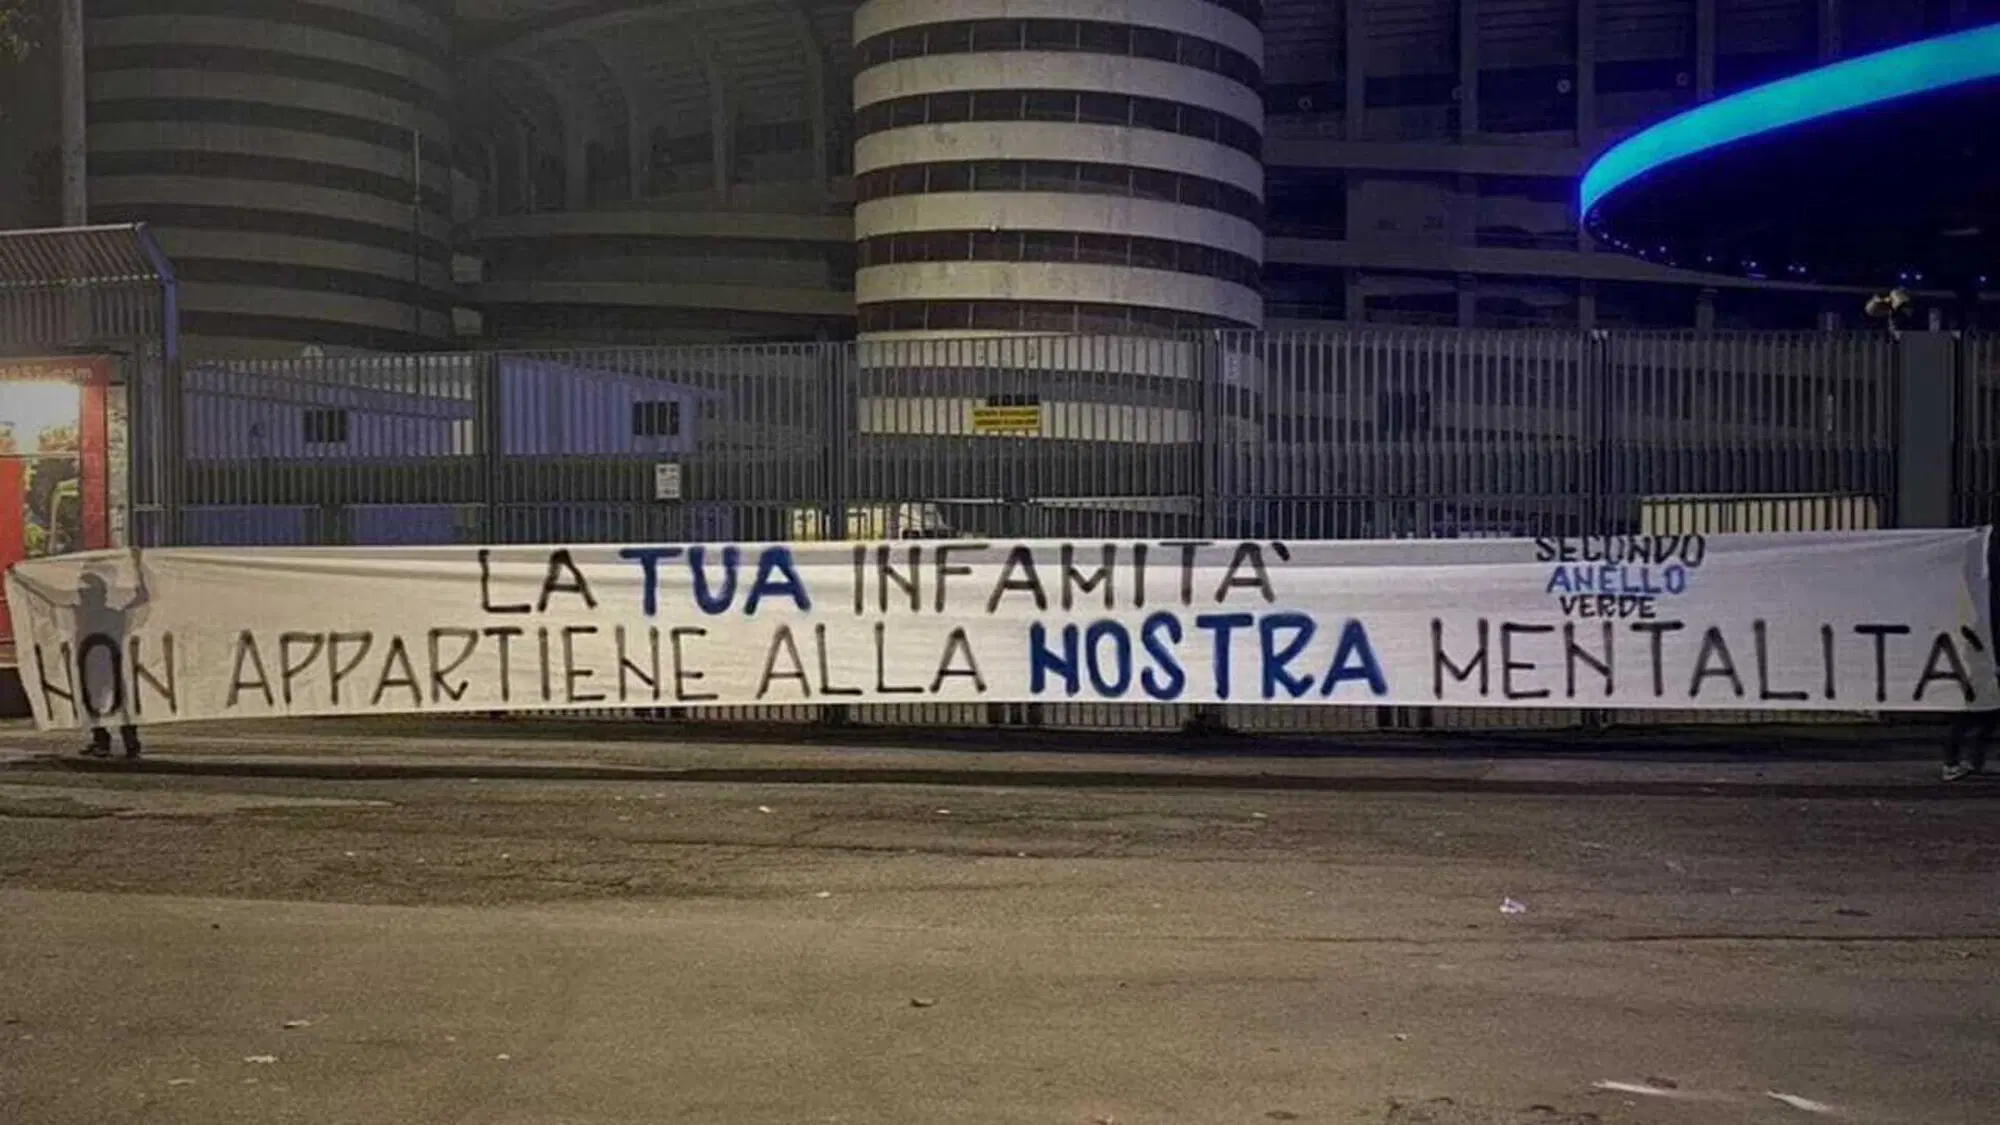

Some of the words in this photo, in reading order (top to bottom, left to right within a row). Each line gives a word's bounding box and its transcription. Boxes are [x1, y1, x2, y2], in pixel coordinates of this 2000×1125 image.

[1535, 534, 1706, 568] SECONDO
[477, 549, 598, 614] LA
[618, 545, 812, 616] TUA
[1546, 564, 1687, 594] ANELLO
[1558, 594, 1657, 618] VERDE
[33, 630, 178, 721] NON
[226, 625, 719, 708] APPARTIENE
[755, 621, 988, 700] ALLA
[1029, 610, 1389, 701] NOSTRA
